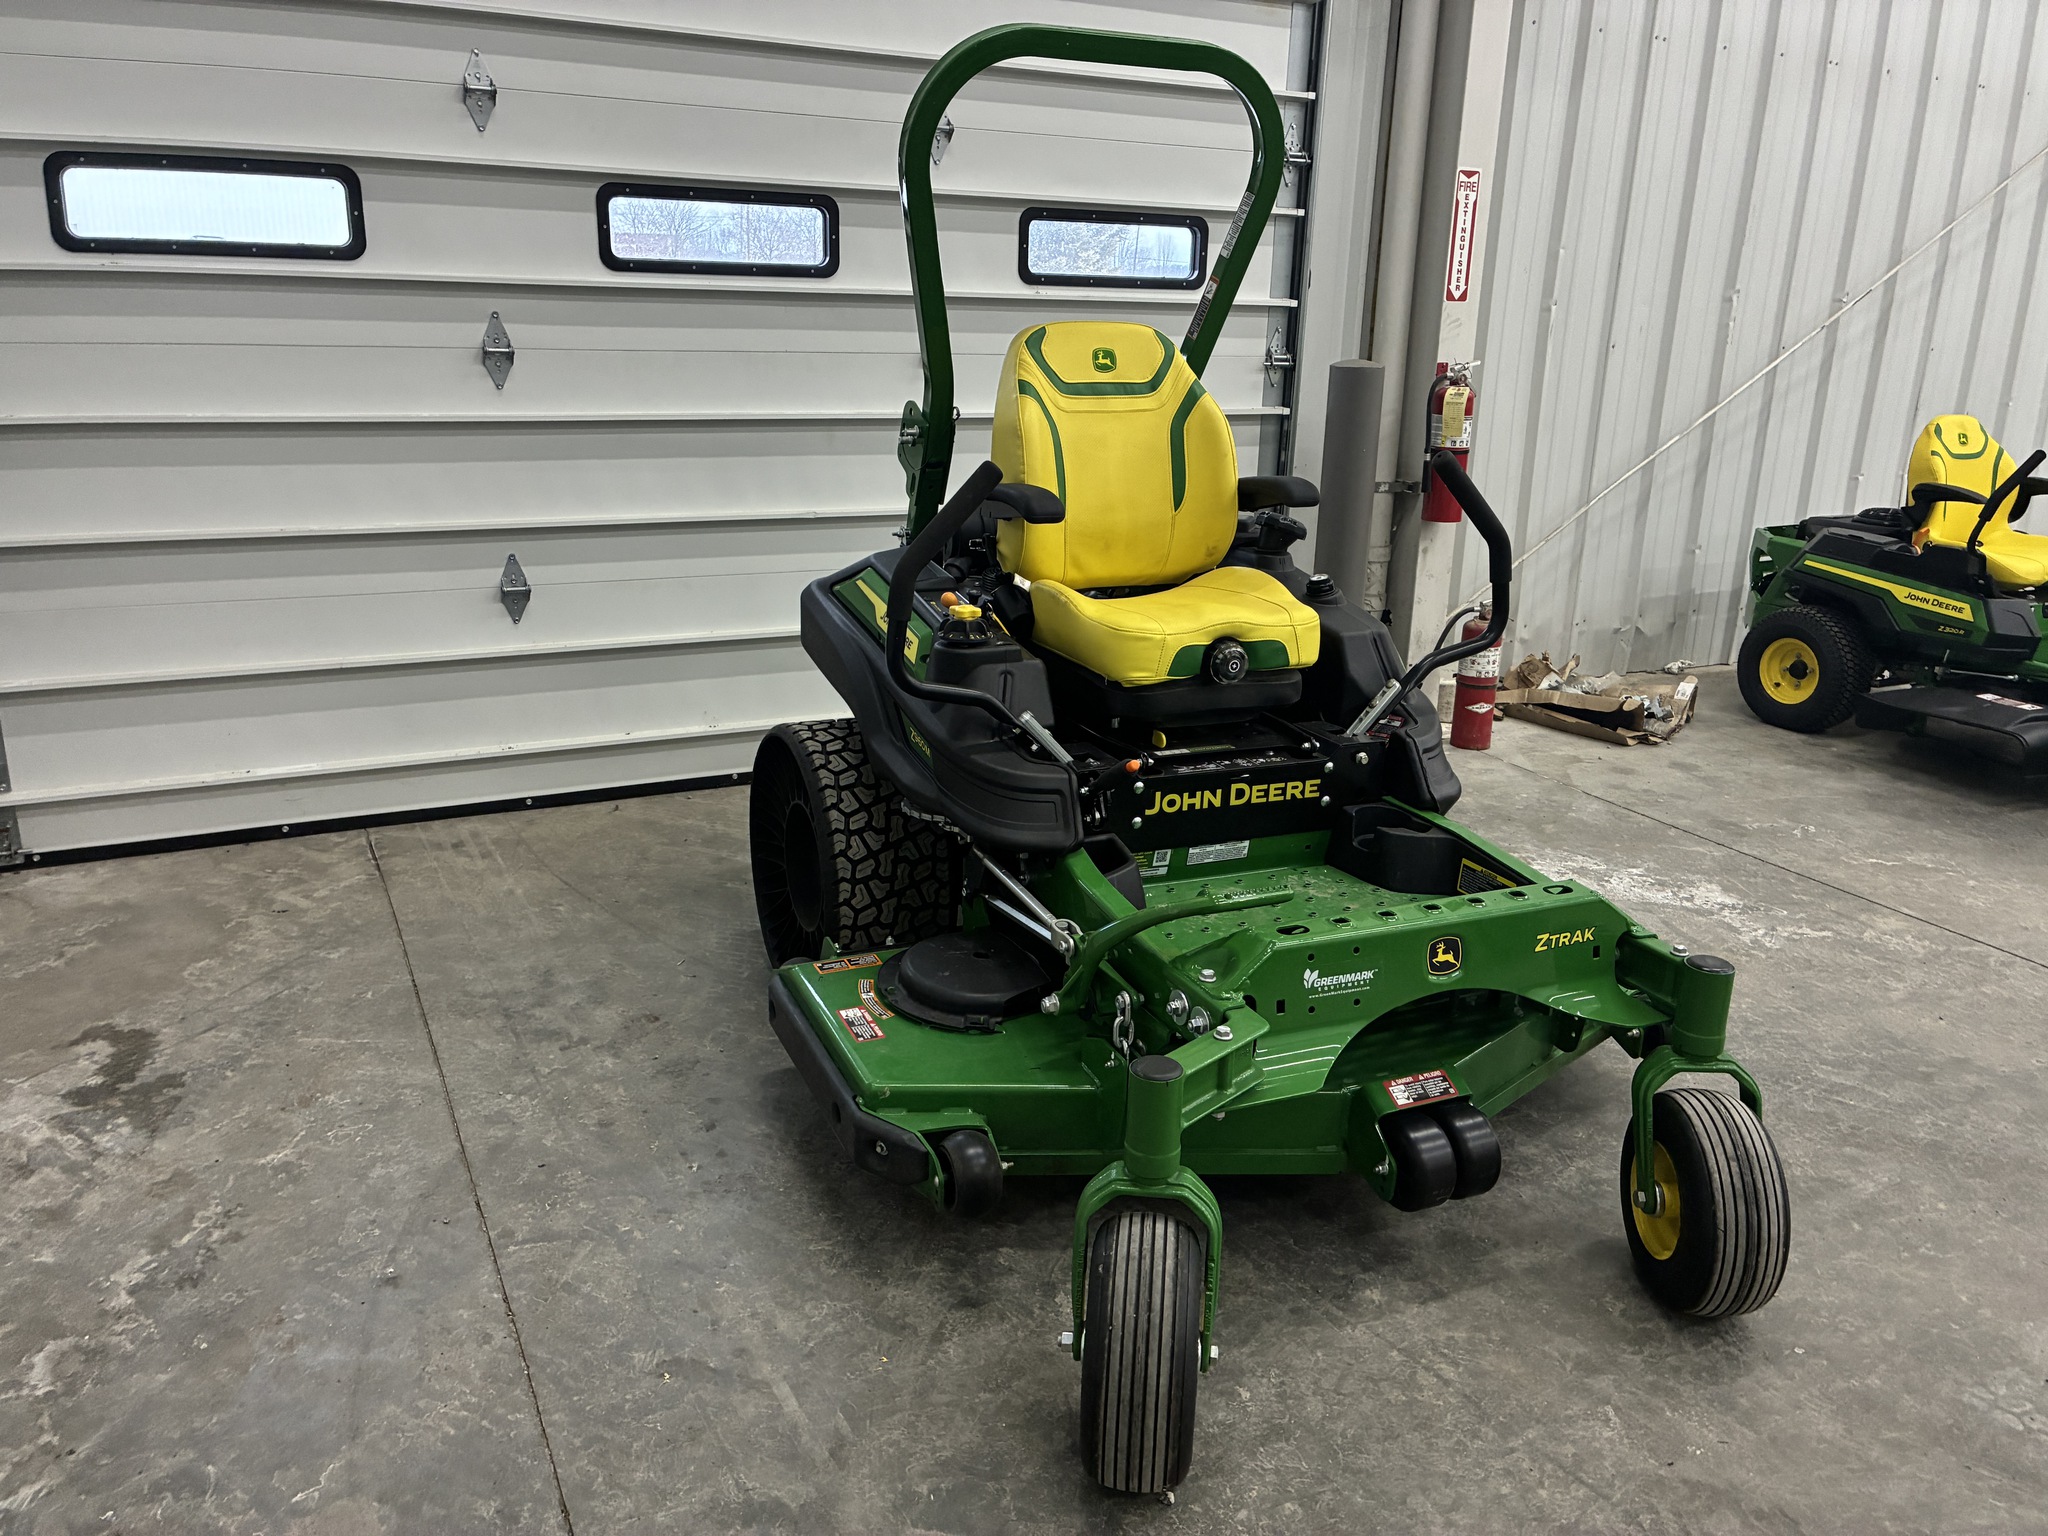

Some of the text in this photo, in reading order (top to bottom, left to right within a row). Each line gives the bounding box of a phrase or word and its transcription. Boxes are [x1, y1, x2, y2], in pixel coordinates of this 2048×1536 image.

[1458, 181, 1477, 193] FIRE
[1455, 193, 1470, 292] EXTINGUISHER
[1904, 592, 1965, 614] JOHN DEERE
[1144, 778, 1322, 816] JOHN DEERE
[1534, 926, 1596, 952] ZTRAK
[1317, 979, 1370, 992] EQUIPMENT
